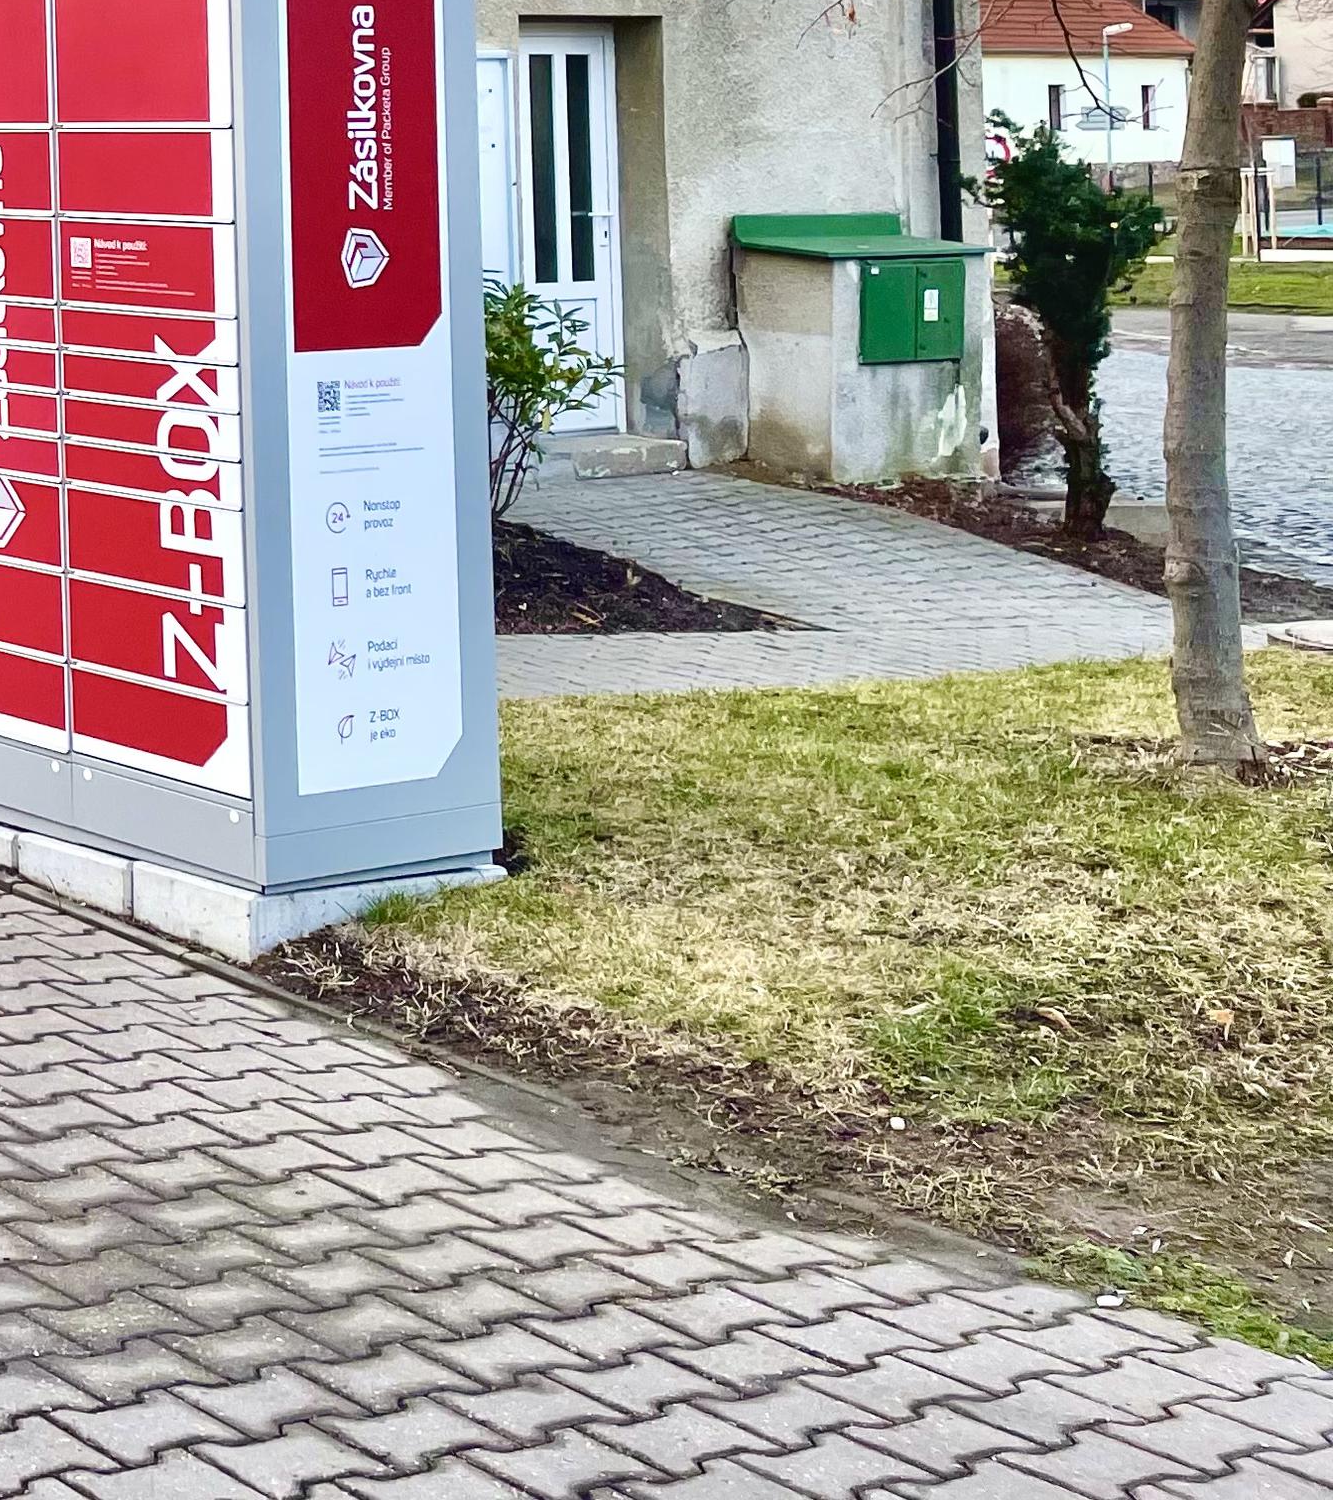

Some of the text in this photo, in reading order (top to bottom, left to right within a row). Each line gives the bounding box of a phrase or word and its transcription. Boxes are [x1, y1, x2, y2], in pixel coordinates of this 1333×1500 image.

[347, 4, 379, 210] Zásilkovna
[380, 47, 393, 210] Member of Packeta Group
[153, 332, 228, 692] Z-BOX
[363, 500, 401, 512] Nonstop
[364, 518, 394, 532] provoz
[365, 568, 397, 583] Rychle
[373, 586, 389, 598] bez
[369, 708, 401, 723] Z-BOX
[370, 730, 378, 742] je
